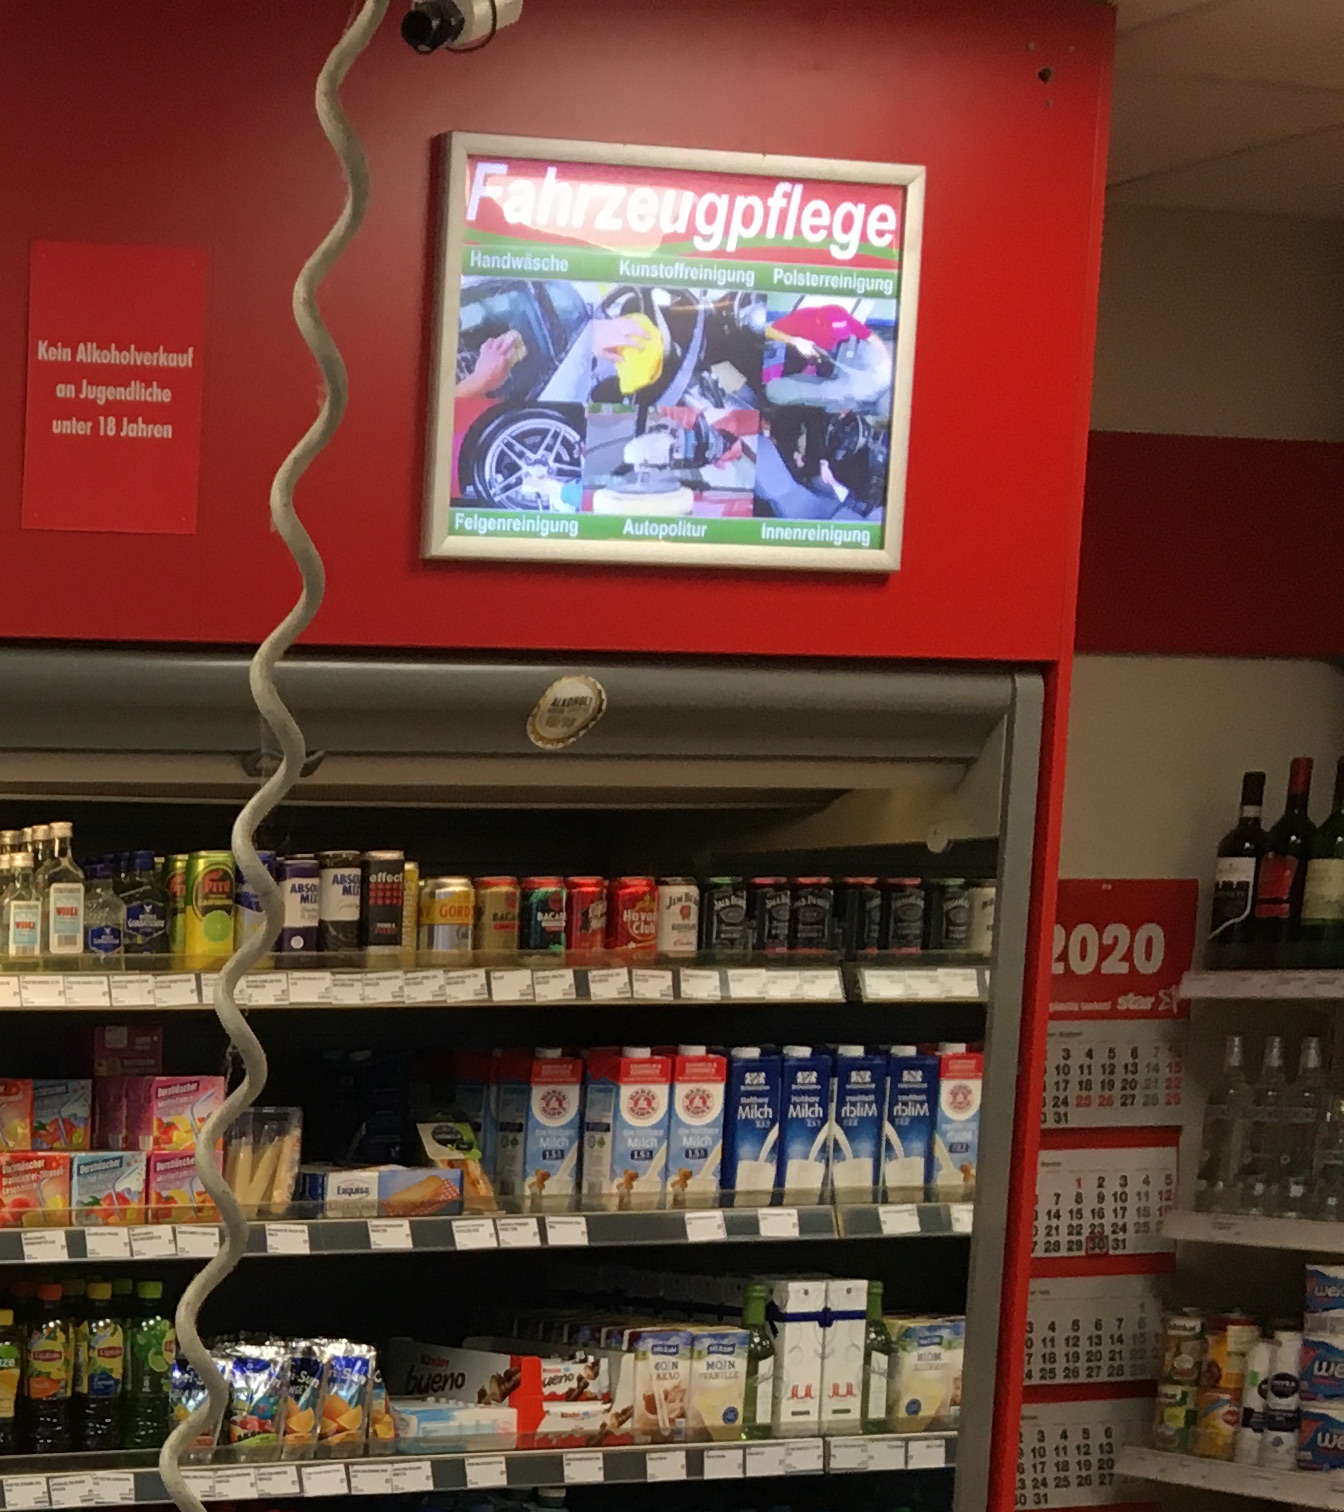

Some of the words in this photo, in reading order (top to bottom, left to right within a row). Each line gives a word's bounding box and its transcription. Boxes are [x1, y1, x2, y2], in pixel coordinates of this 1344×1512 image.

[466, 161, 897, 260] Fahrzeugpflege
[469, 249, 570, 274] Handwäsche
[618, 258, 756, 287] Kunstoffreinigung
[772, 266, 895, 295] Polsterreinigung
[37, 340, 72, 363] Kein
[76, 342, 194, 368] Alkoholverkauf
[56, 381, 76, 399] an
[79, 379, 173, 406] Jugendliche
[52, 417, 93, 436] unter
[98, 416, 117, 437] 18
[120, 417, 174, 440] Jahren
[454, 512, 580, 538] Felgenreinigung
[622, 518, 709, 540] Autopolitur
[761, 521, 872, 546] Innenreinigung
[1052, 923, 1166, 975] 2020
[736, 1104, 774, 1120] Milch
[787, 1104, 824, 1120] Milch
